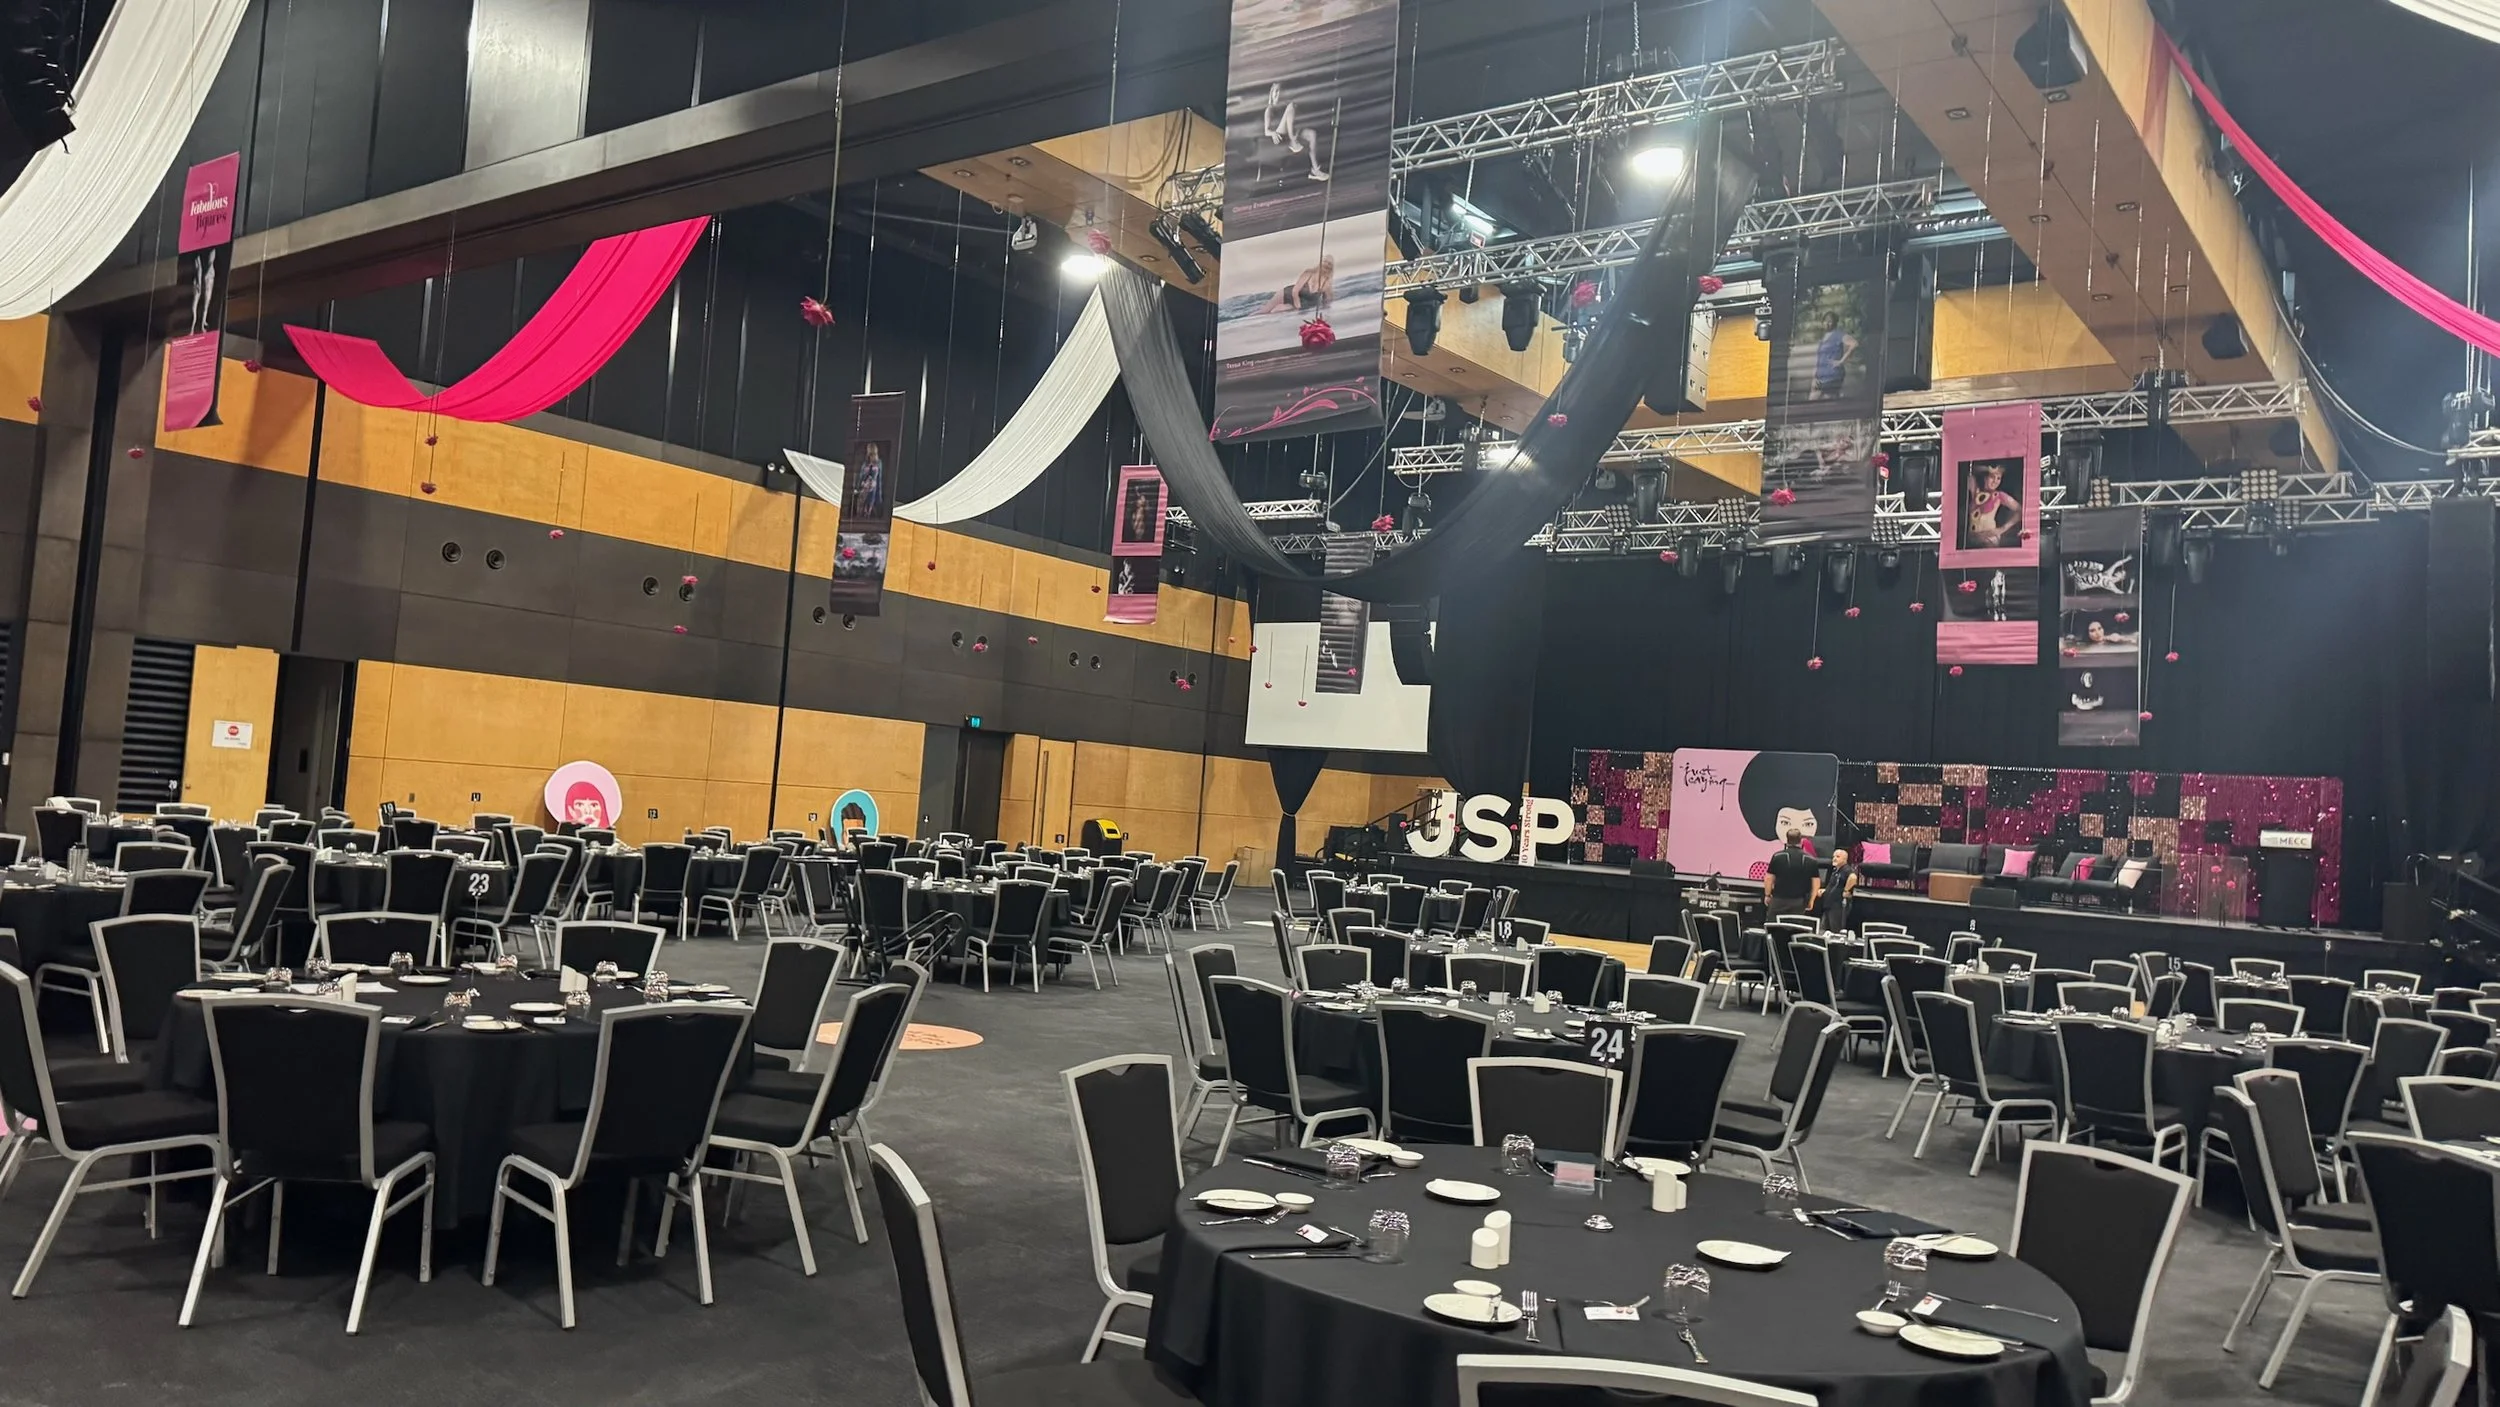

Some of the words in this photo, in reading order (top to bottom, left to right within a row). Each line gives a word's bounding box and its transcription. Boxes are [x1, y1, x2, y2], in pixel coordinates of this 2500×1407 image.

[190, 182, 228, 216] Fabulous
[383, 802, 395, 814] 19
[1524, 798, 1534, 828] Strong
[1406, 791, 1576, 866] JSP
[1522, 829, 1530, 852] Years
[2279, 836, 2308, 846] MECC
[468, 873, 490, 895] 23
[1498, 921, 1512, 938] 18
[2168, 956, 2181, 971] 15
[1590, 1026, 1625, 1060] 24
